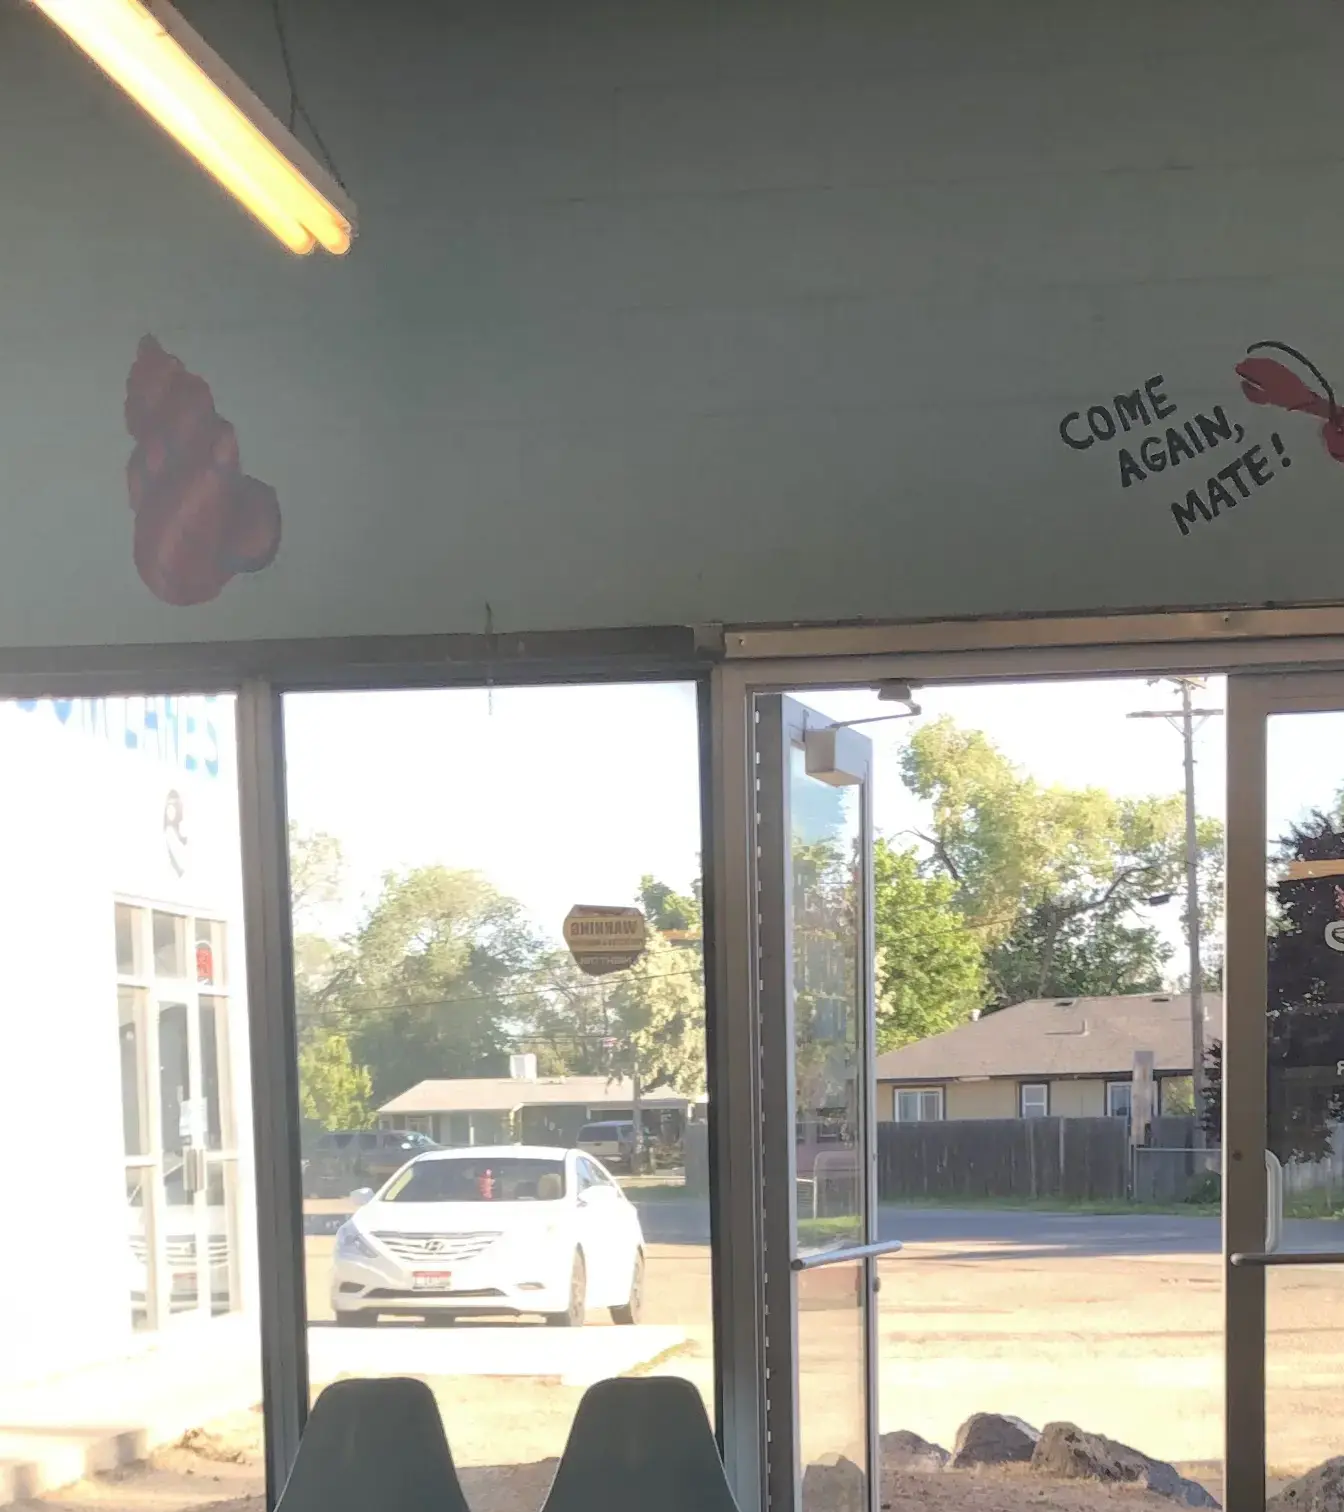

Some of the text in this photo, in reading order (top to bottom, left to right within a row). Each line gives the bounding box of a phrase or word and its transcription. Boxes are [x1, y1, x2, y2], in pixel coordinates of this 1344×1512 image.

[1059, 375, 1177, 450] COME
[1117, 405, 1245, 487] AGAIN,
[1170, 433, 1292, 536] MATE!
